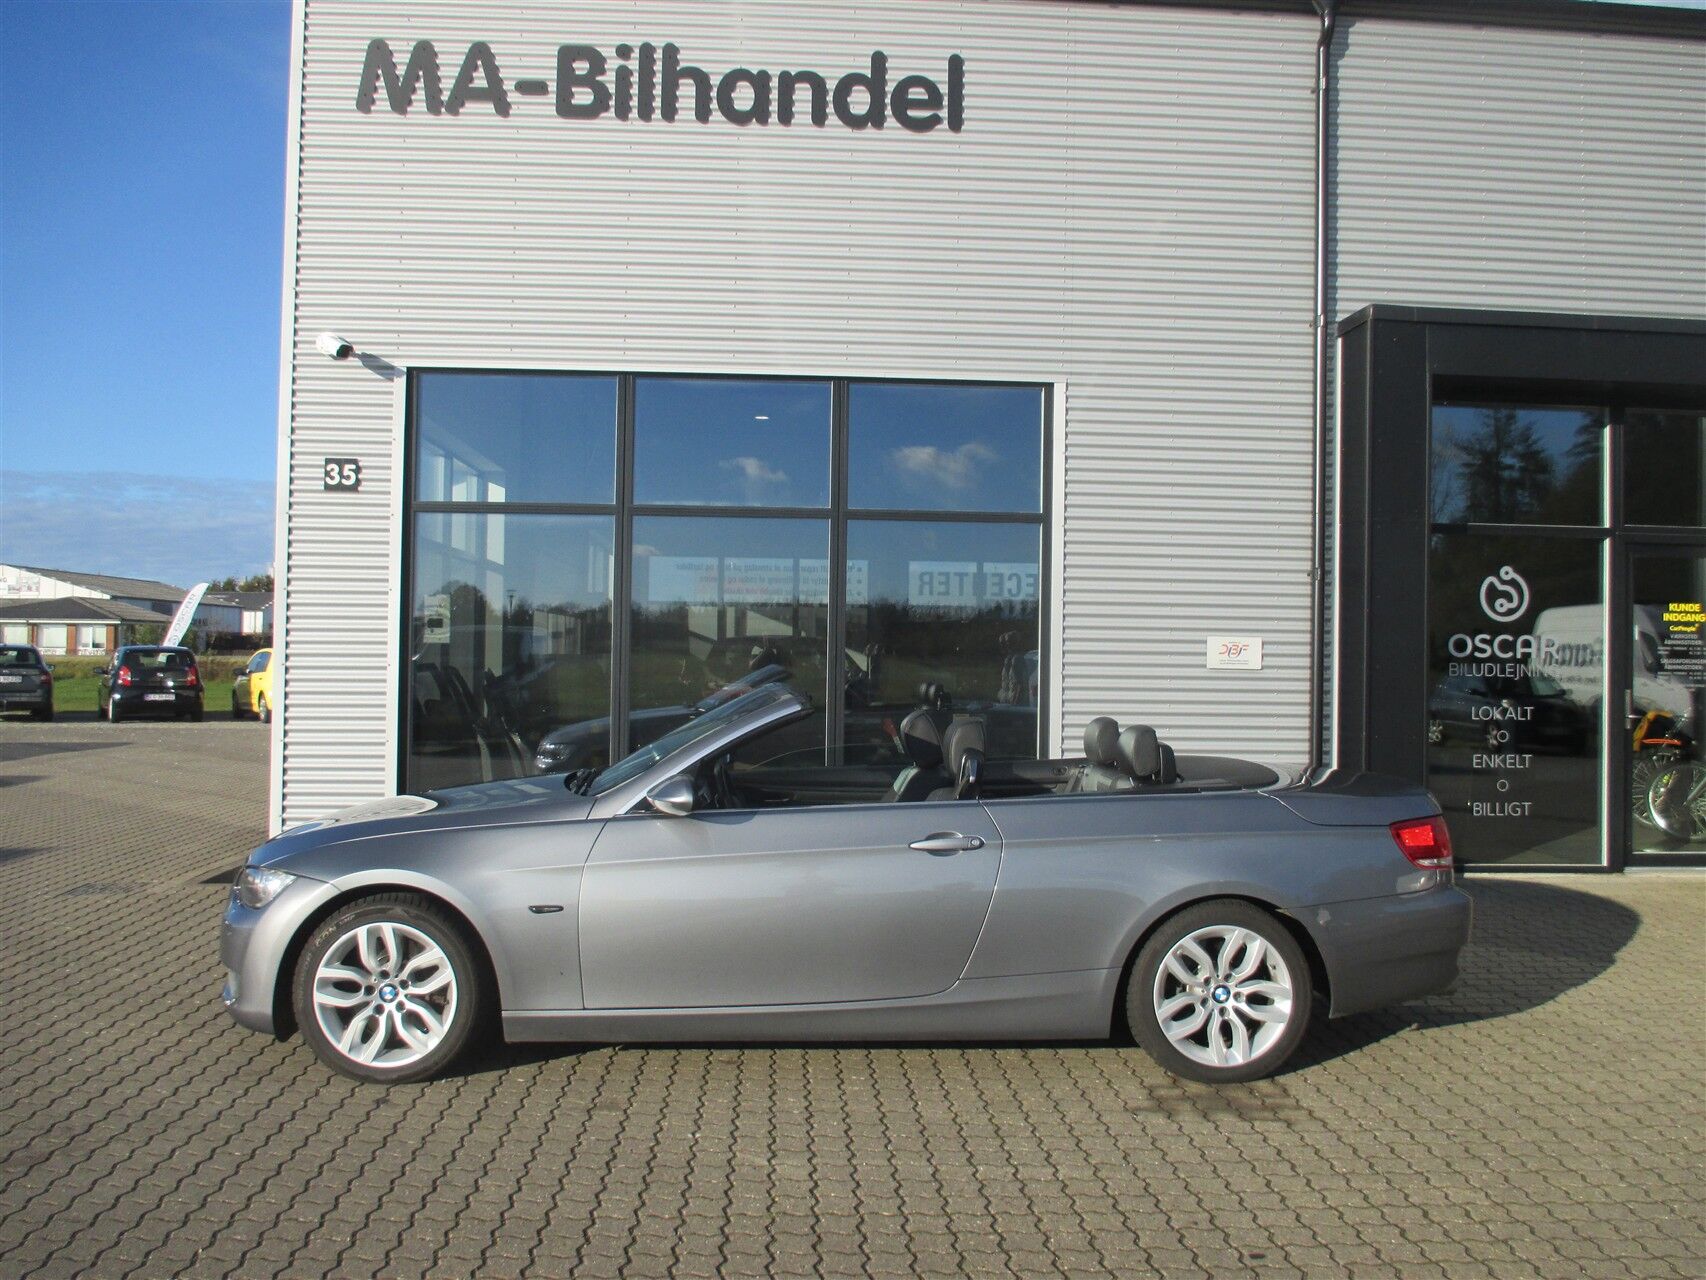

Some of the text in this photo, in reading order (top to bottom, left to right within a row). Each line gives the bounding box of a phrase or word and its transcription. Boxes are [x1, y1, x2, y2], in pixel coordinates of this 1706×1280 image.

[355, 38, 966, 133] MA-Bilhandel
[325, 463, 356, 486] 35
[1668, 603, 1701, 612] KUNDE
[1663, 612, 1706, 622] INDGANG
[1448, 633, 1560, 659] OSCAR
[1471, 706, 1534, 721] LOKALT
[1472, 754, 1533, 769] ENKELT
[1472, 802, 1532, 817] BILLIGT
